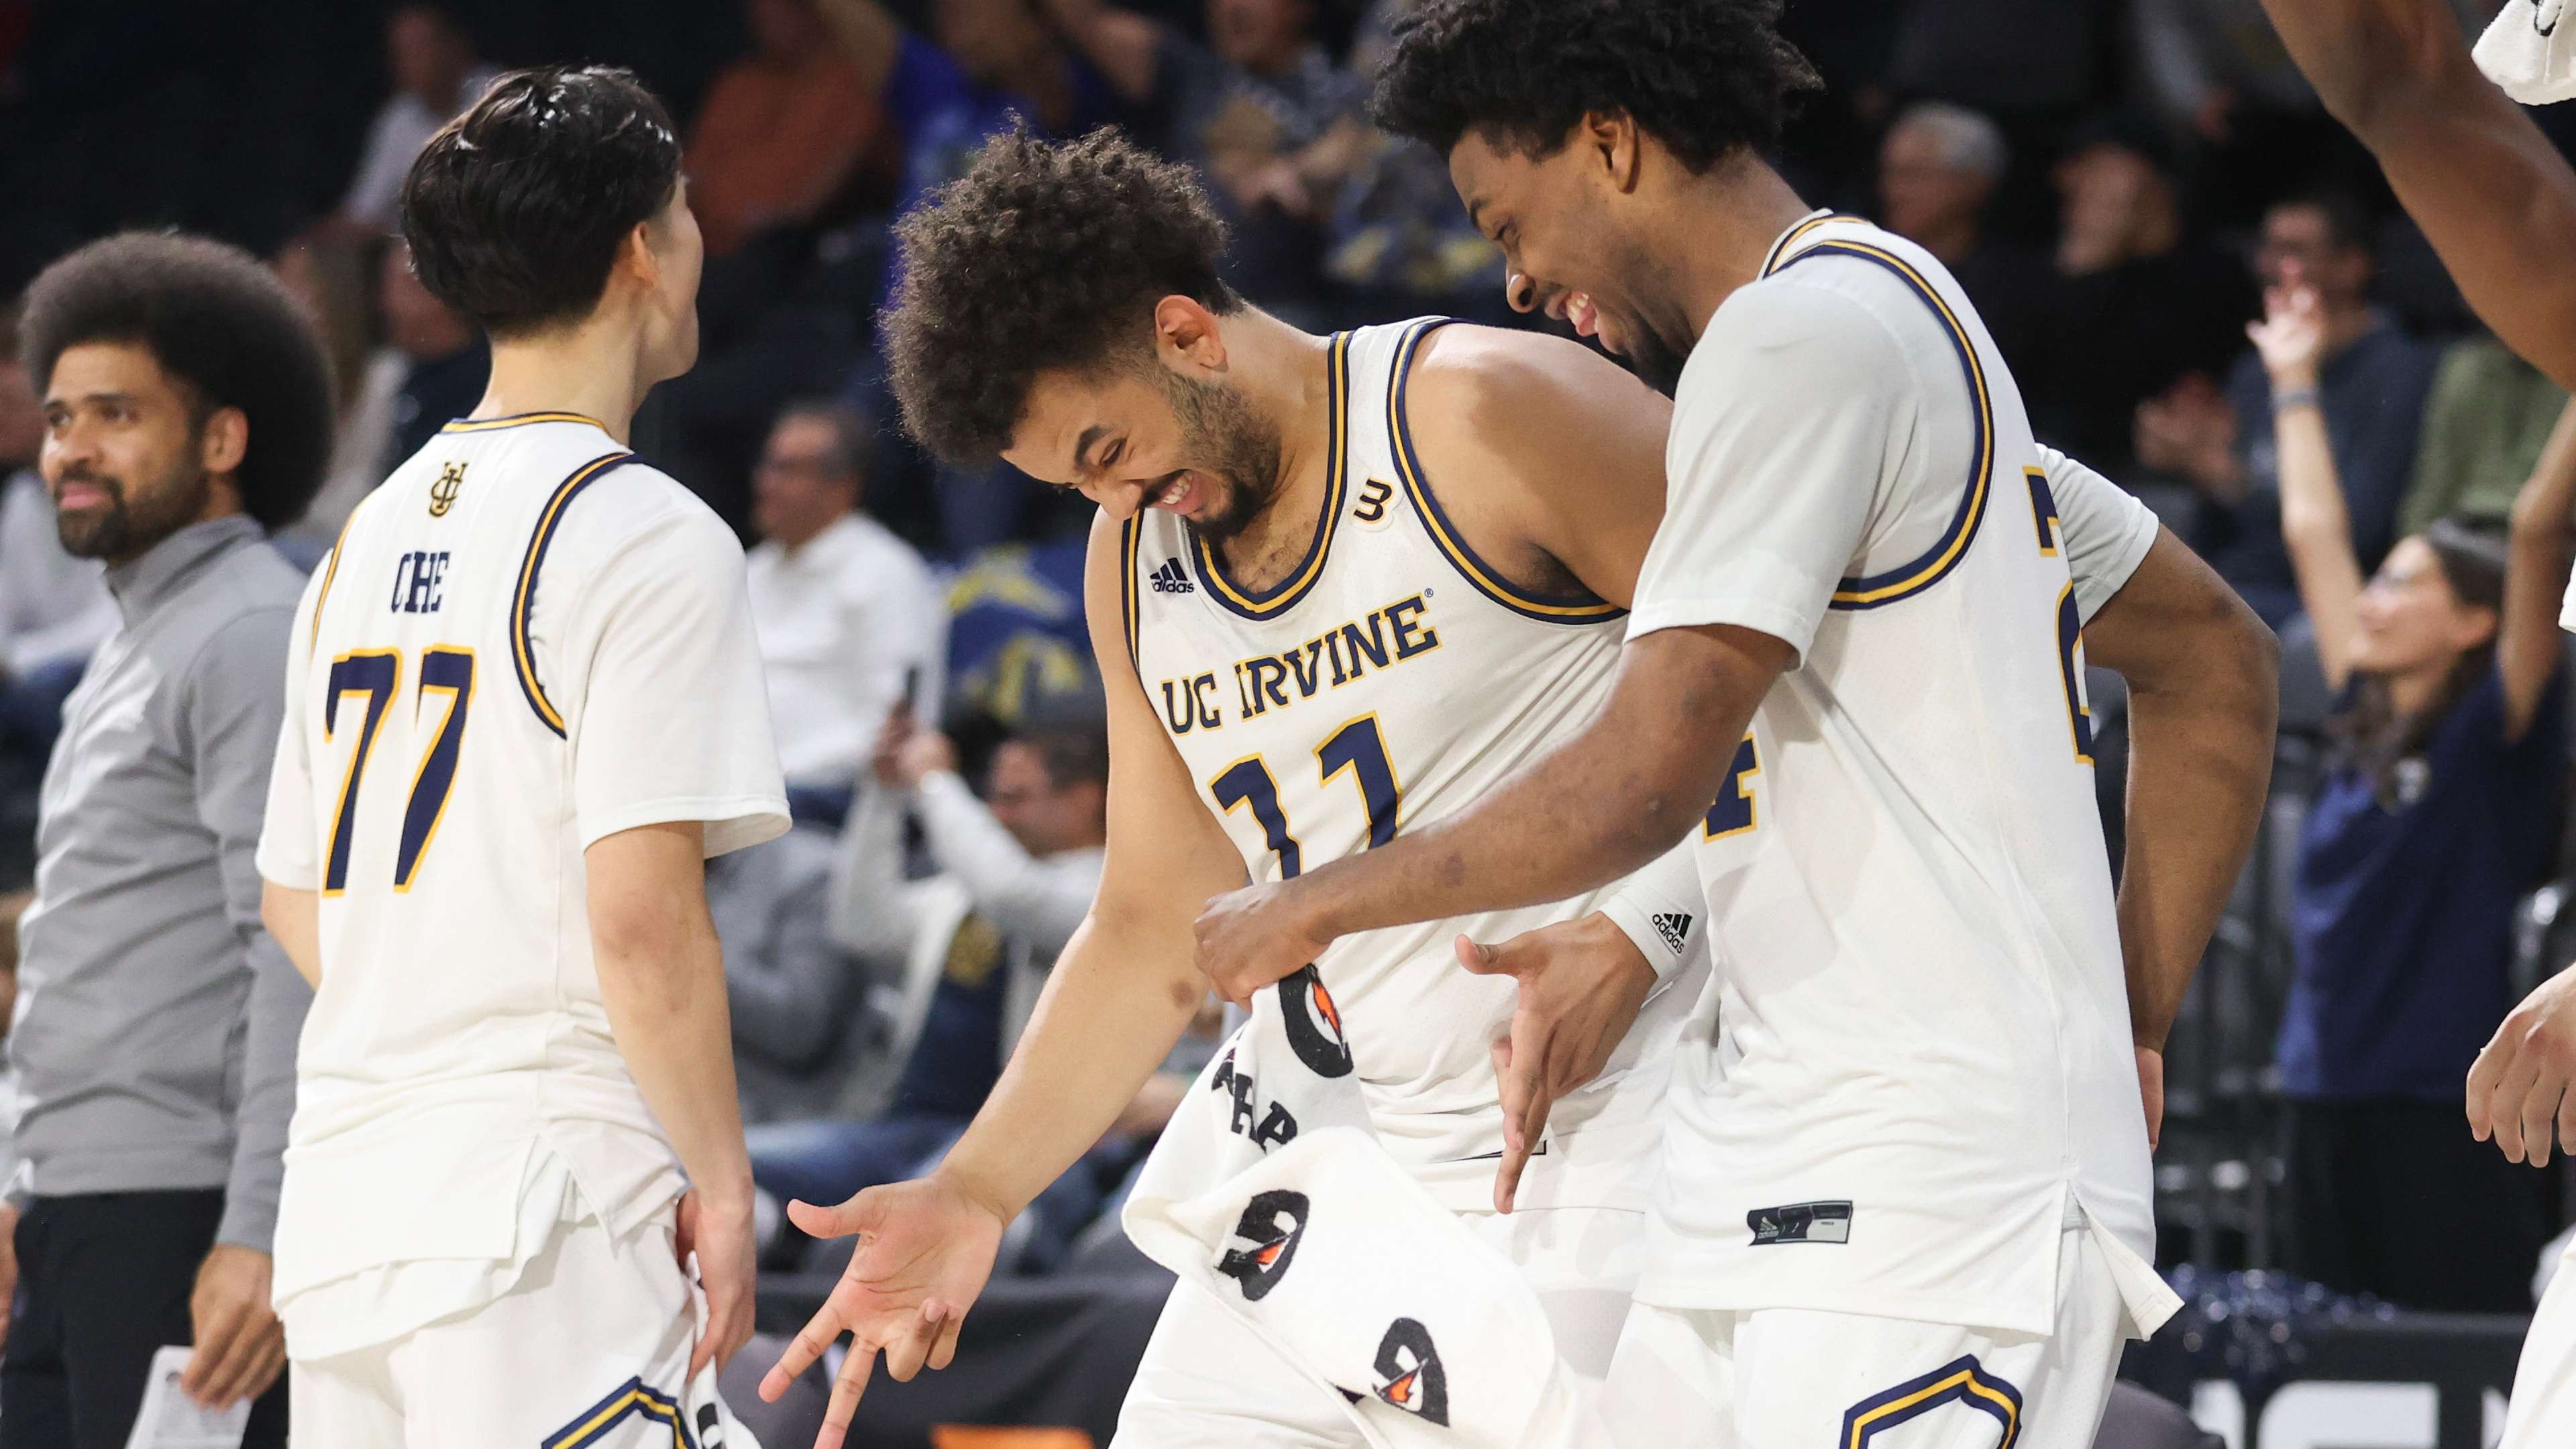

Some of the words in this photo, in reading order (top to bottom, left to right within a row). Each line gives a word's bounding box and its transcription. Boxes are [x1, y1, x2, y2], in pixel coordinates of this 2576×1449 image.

[391, 551, 450, 613] CHE
[1151, 579, 1194, 594] didas
[1161, 669, 1222, 737] UC
[1234, 592, 1443, 720] IRVINE
[322, 643, 478, 897] 77
[1208, 710, 1402, 881] 11
[1652, 914, 1684, 954] adidas
